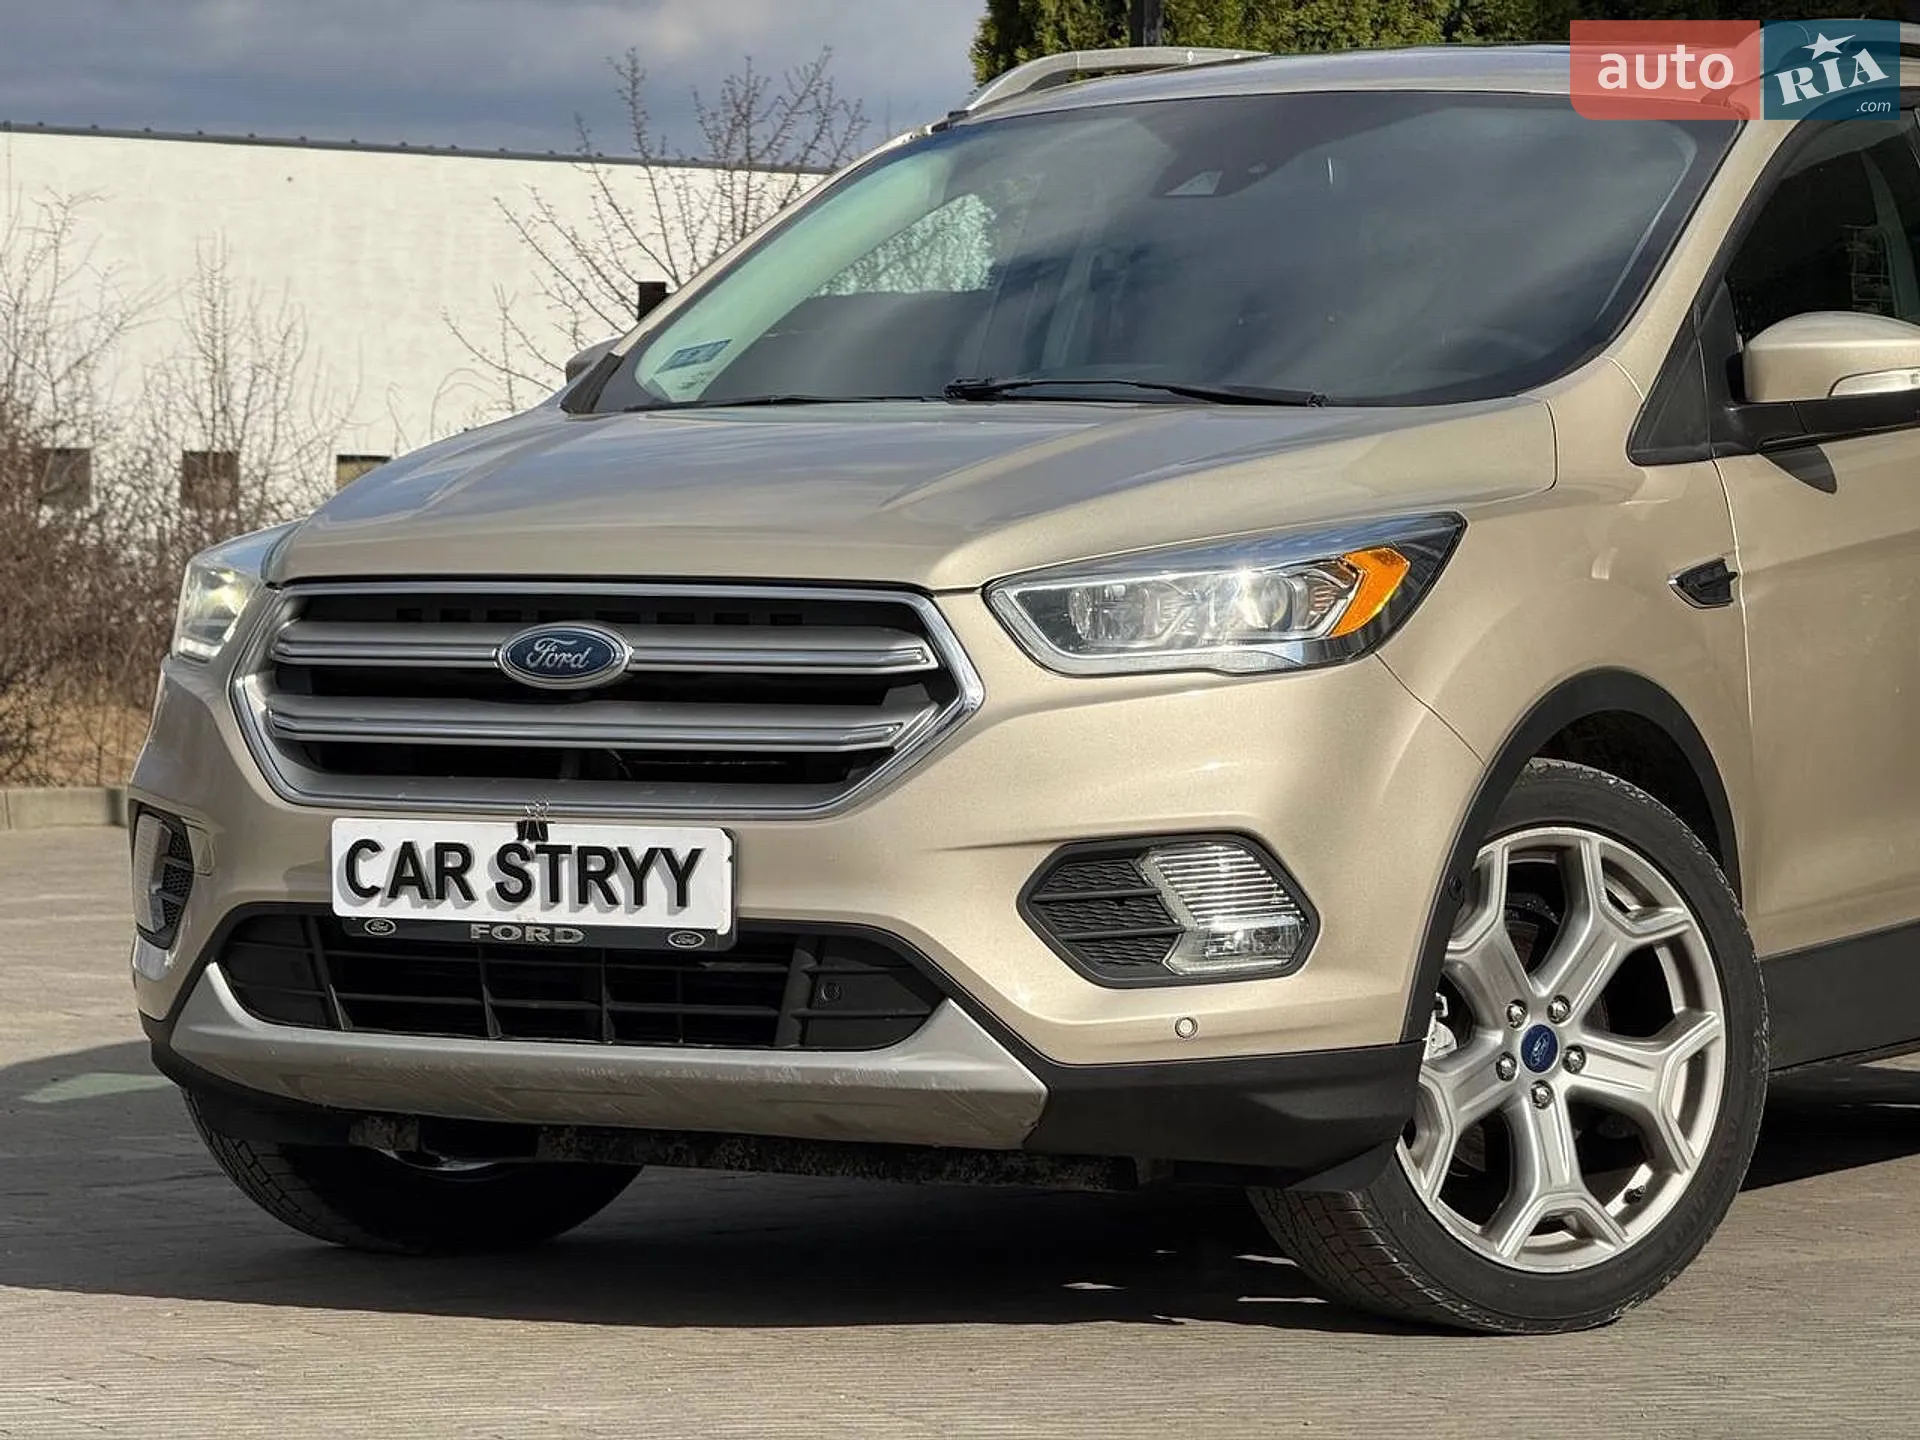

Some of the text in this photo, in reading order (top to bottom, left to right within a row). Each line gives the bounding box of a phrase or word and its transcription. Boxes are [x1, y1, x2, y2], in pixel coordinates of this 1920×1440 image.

[525, 637, 593, 669] Ford
[344, 838, 702, 908] CAR STRYY
[470, 923, 585, 944] FORD
